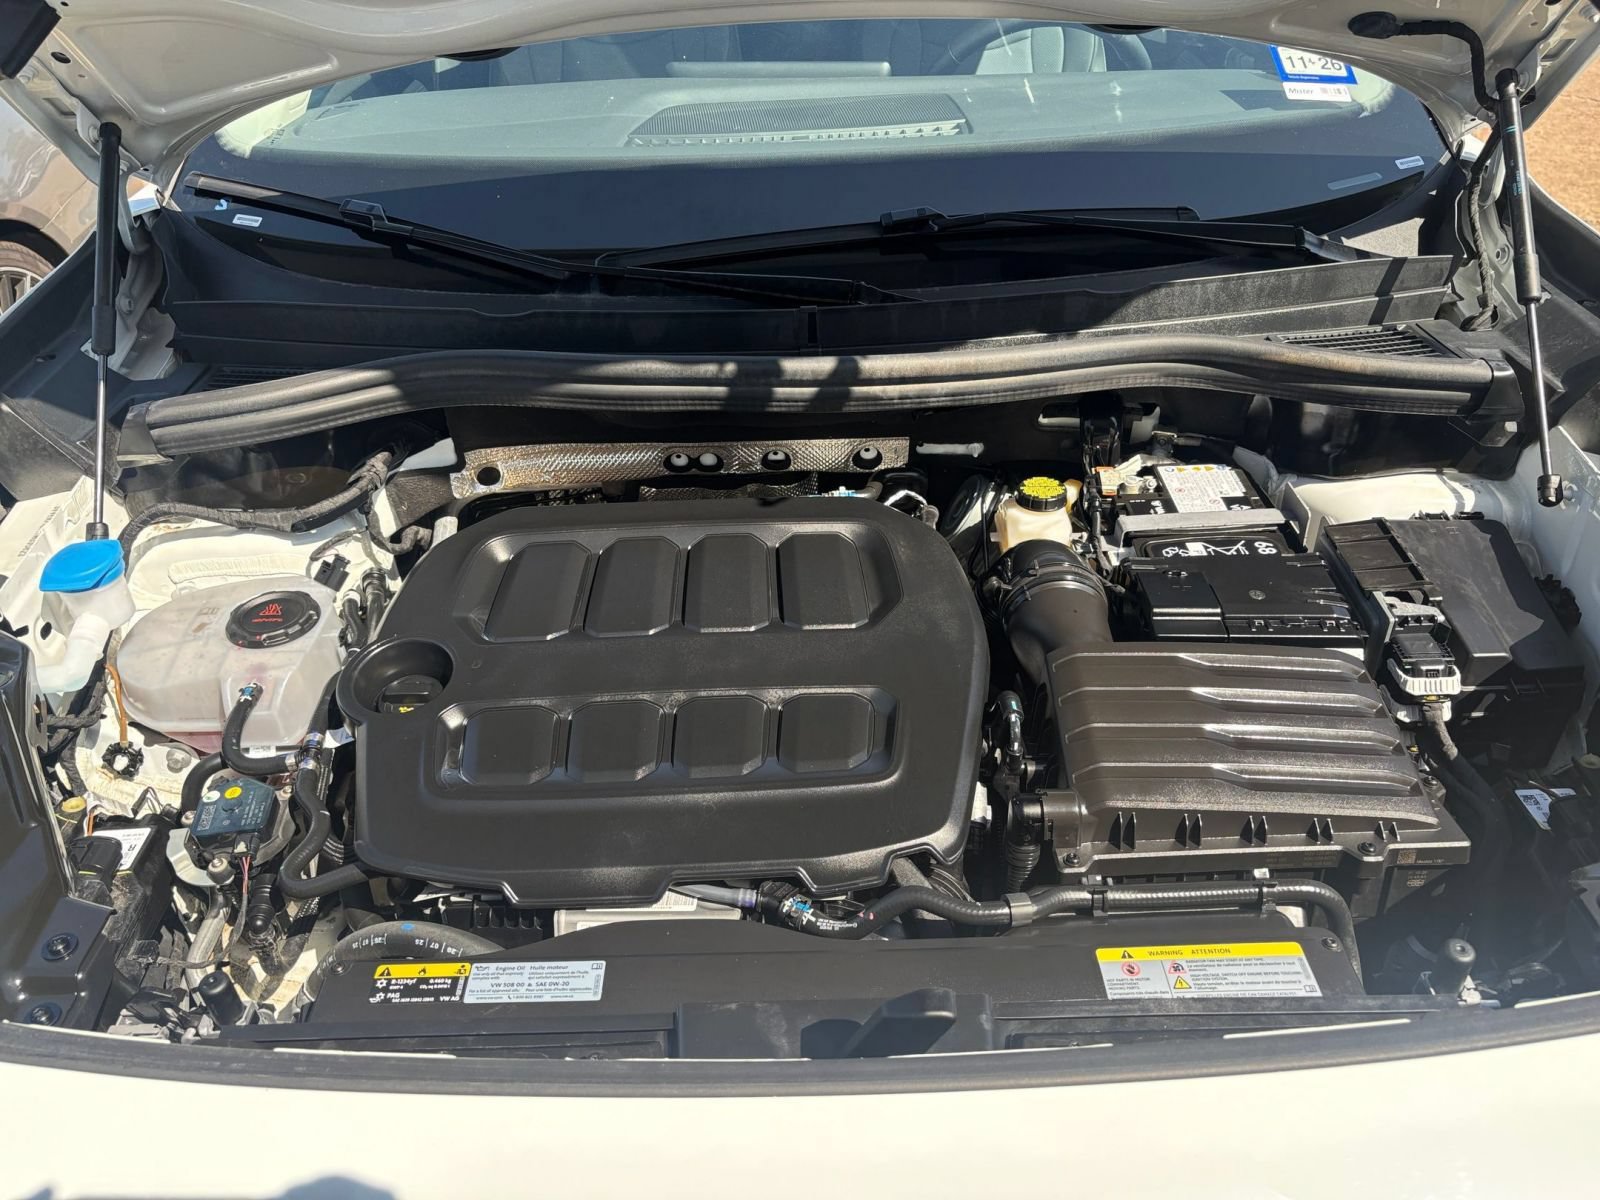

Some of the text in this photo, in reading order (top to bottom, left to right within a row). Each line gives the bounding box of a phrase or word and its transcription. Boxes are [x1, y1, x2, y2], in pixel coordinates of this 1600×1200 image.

[1285, 55, 1343, 71] 11 26
[1191, 947, 1232, 955] ATTENTION
